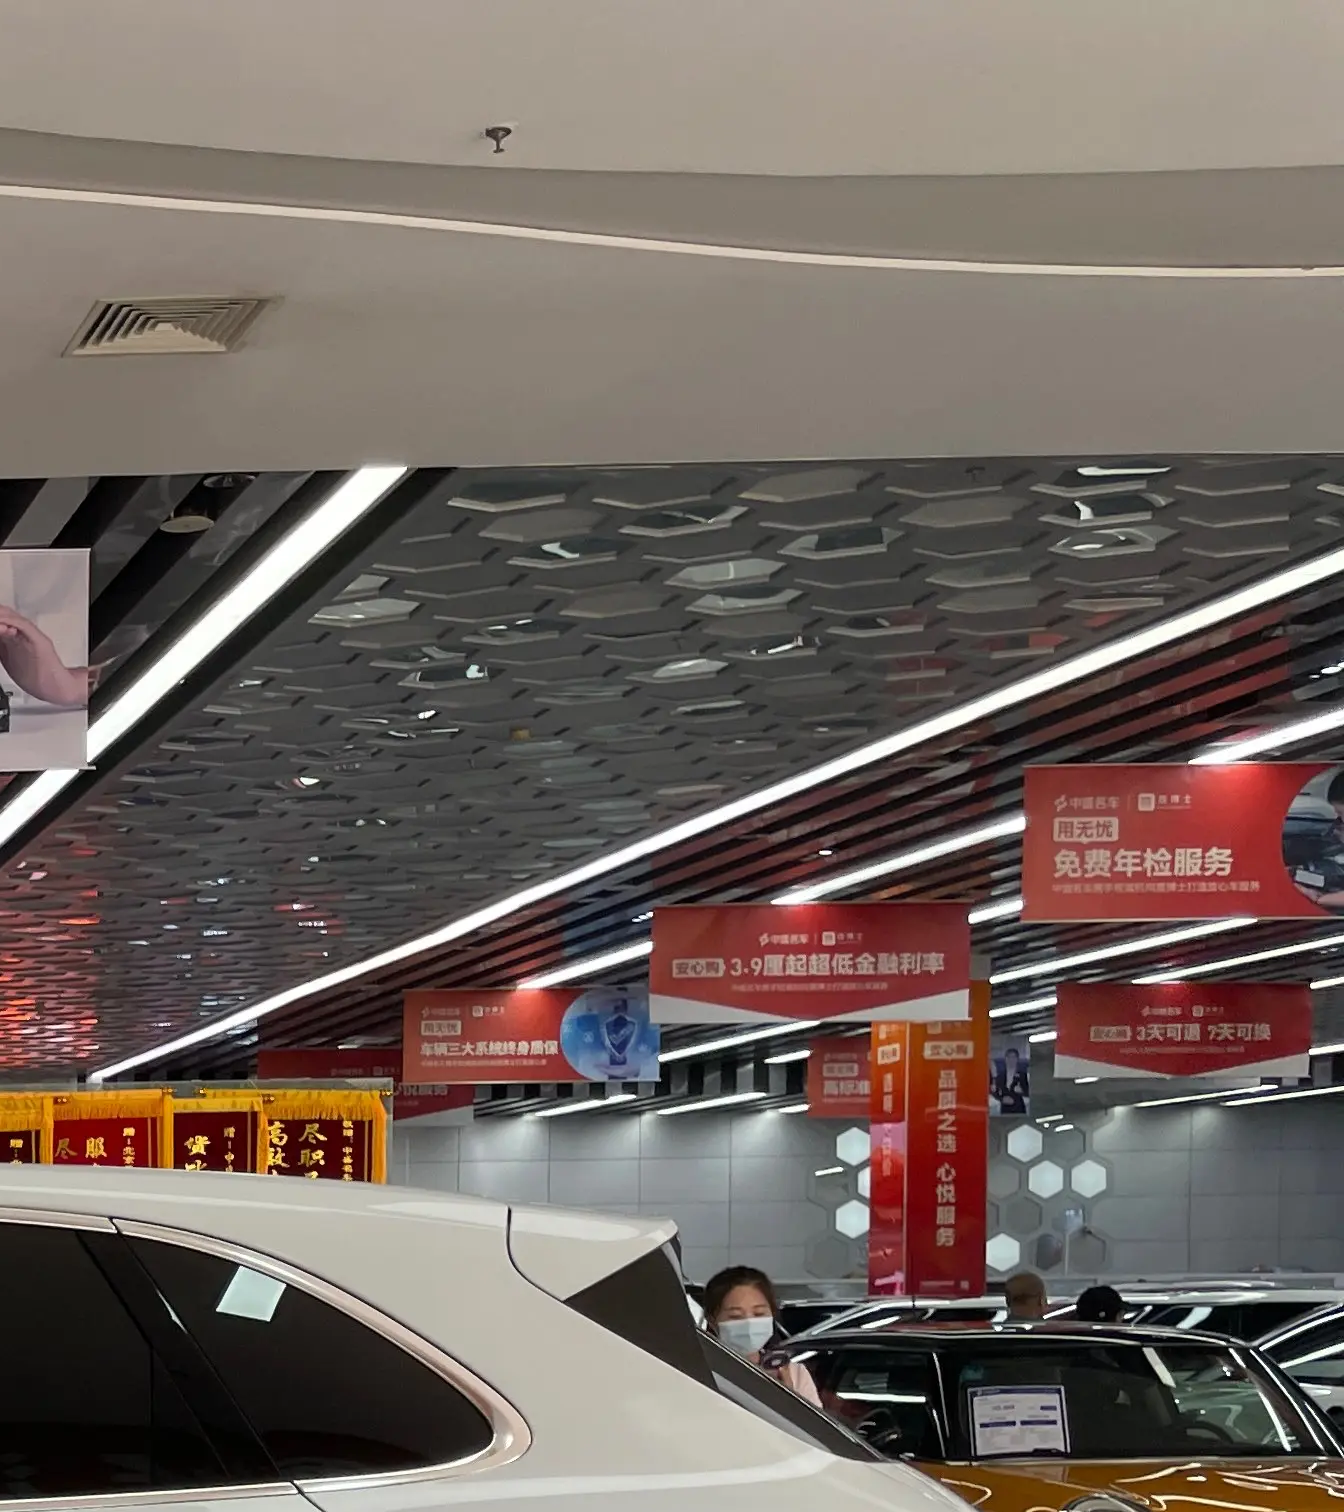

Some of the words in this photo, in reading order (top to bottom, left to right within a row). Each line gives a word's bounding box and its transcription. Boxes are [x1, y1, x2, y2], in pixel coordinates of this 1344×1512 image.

[1058, 819, 1114, 839] 用无忧
[1053, 846, 1234, 878] 免费年检服务
